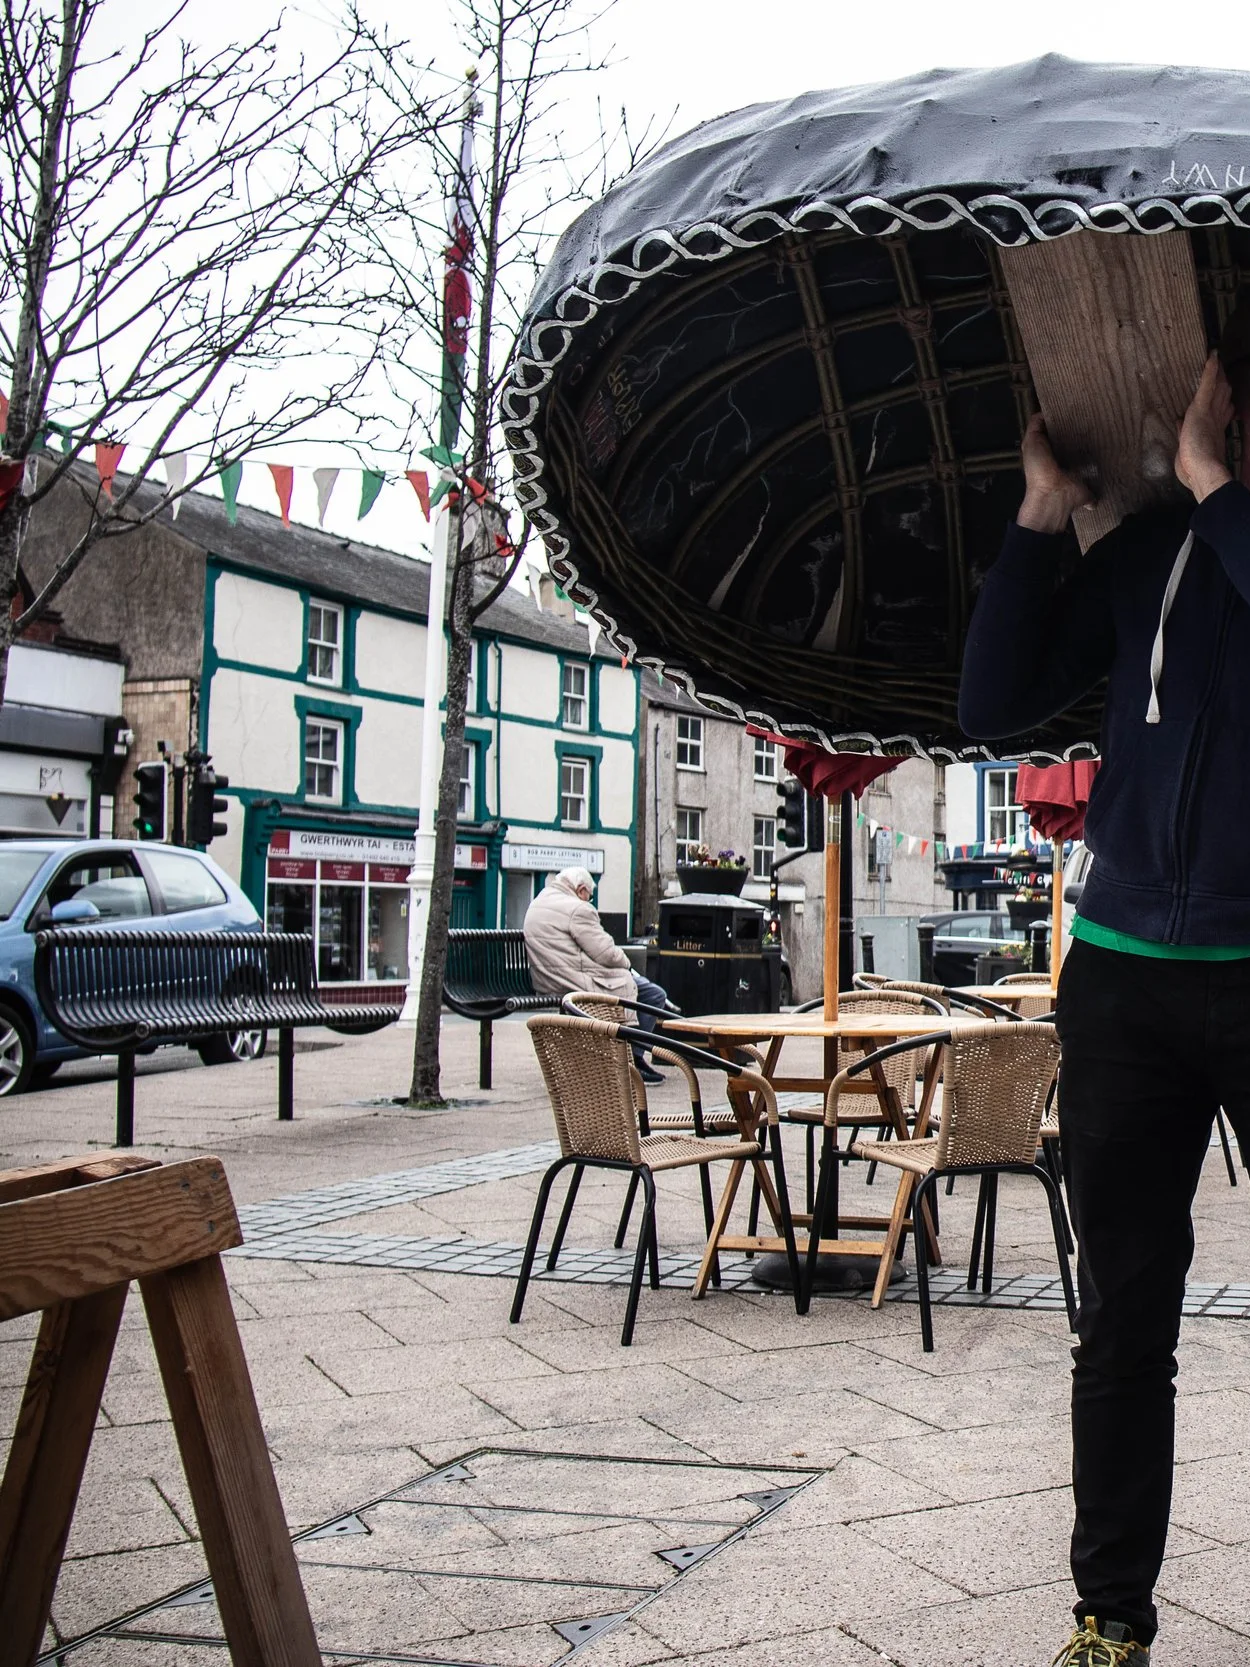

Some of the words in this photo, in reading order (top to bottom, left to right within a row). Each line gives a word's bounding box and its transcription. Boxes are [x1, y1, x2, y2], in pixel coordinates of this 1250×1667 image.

[300, 833, 364, 848] GWERTHWYR
[367, 837, 381, 849] TAI
[392, 841, 415, 852] ESTA
[676, 940, 702, 951] Litter
